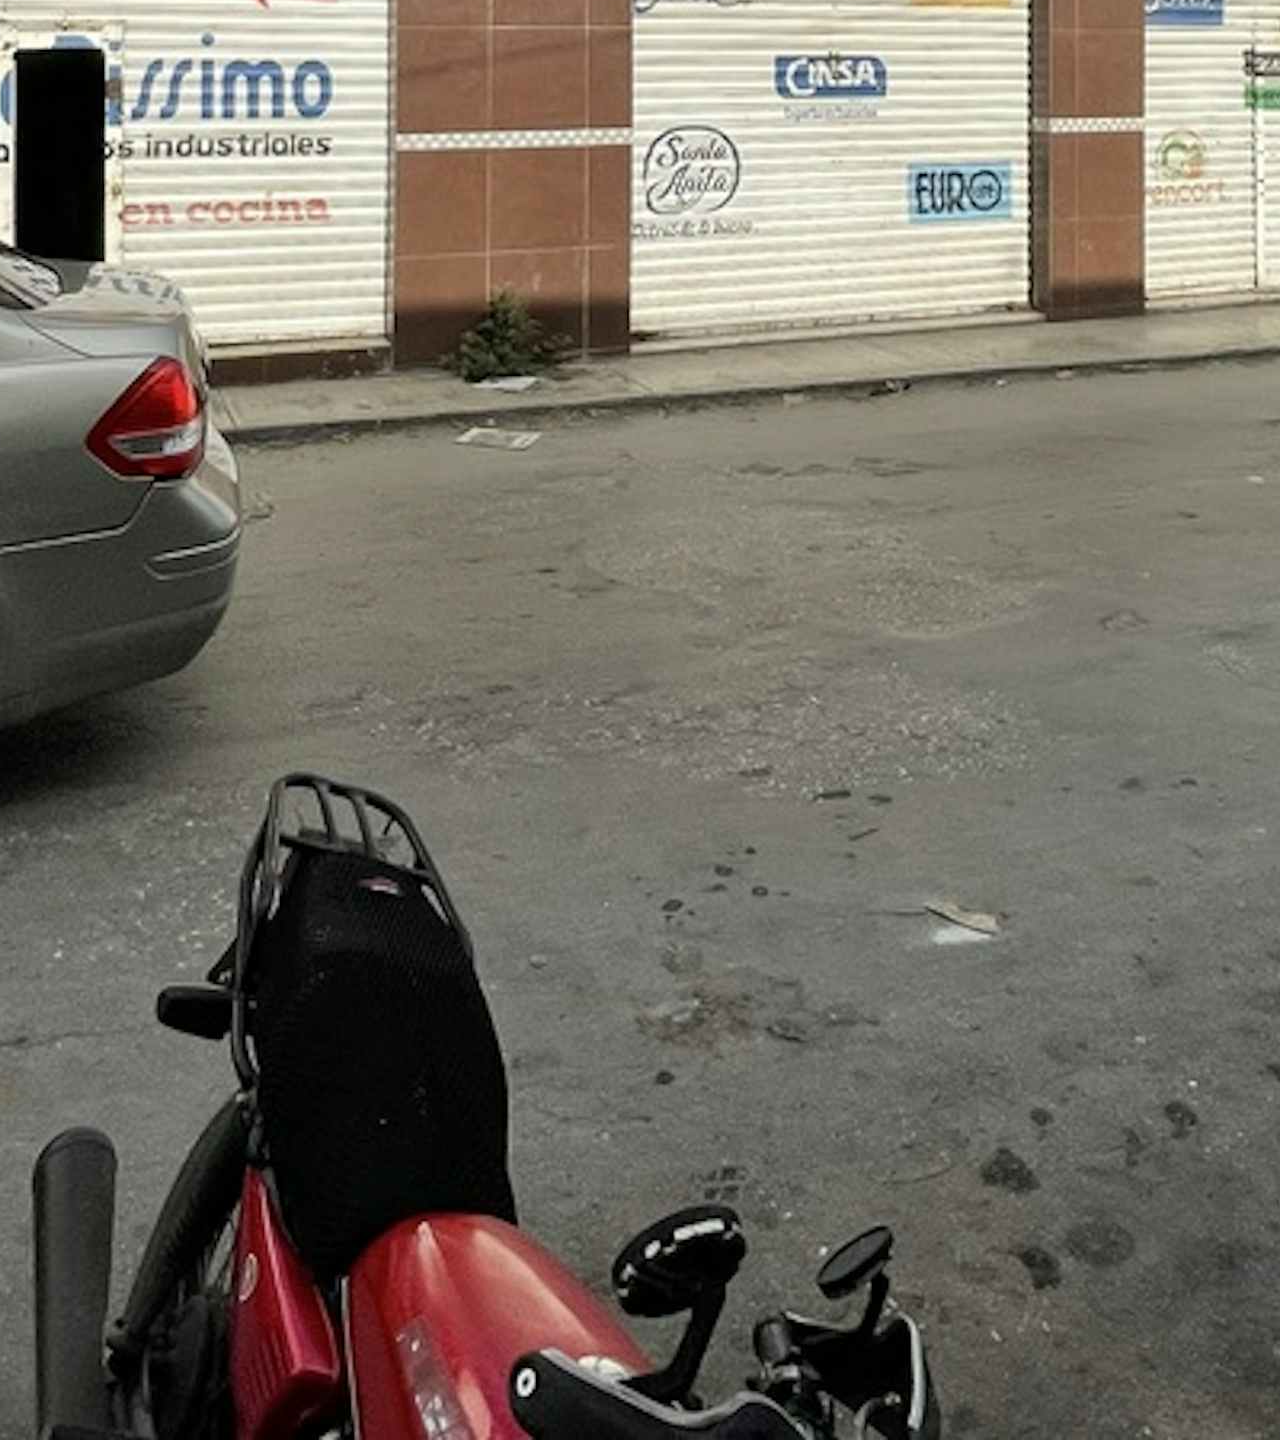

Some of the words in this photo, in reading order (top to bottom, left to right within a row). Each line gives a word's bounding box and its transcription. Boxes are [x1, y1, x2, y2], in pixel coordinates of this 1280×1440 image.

[786, 58, 877, 97] CINSA
[145, 133, 333, 159] industriales
[185, 191, 333, 224] cocina
